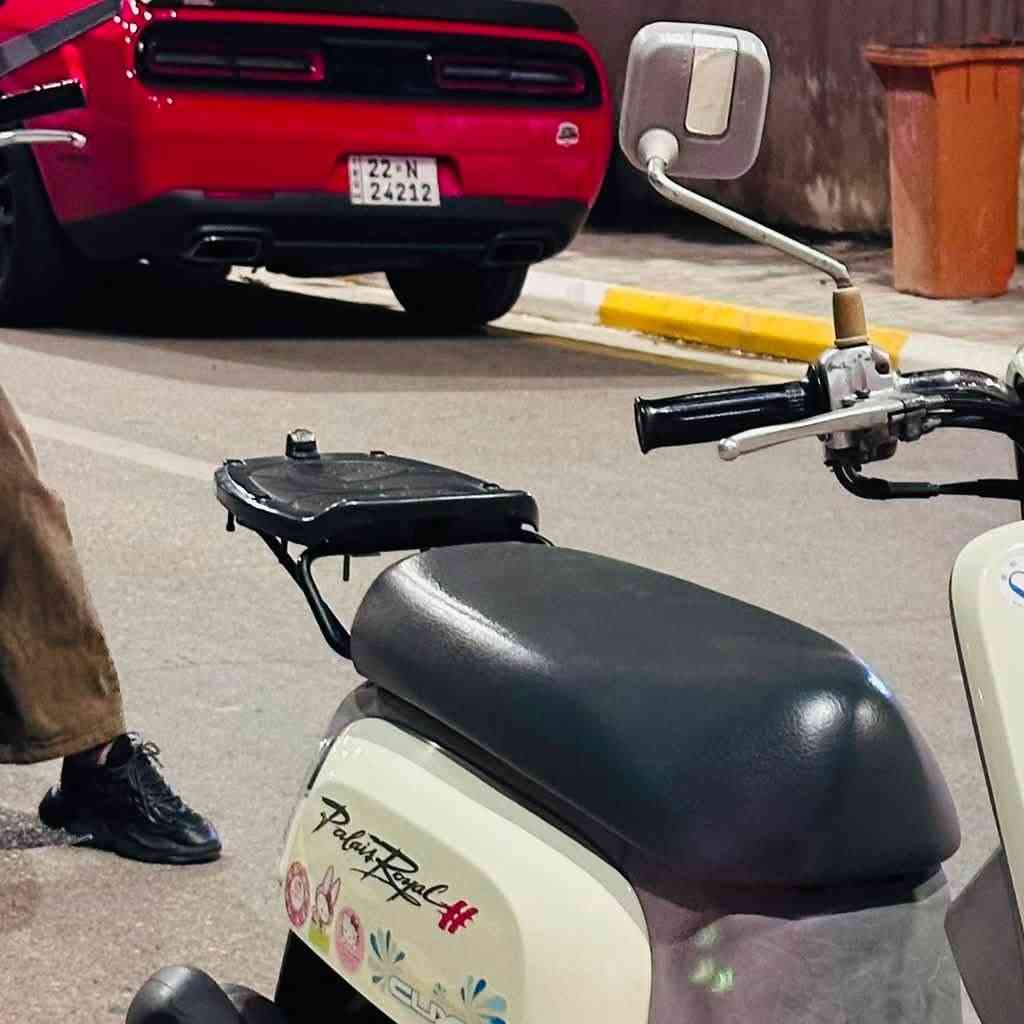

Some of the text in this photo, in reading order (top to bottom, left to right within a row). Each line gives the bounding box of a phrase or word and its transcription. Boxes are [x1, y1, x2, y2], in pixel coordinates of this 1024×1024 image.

[367, 159, 391, 178] 22
[406, 160, 418, 178] N
[370, 182, 431, 201] 24212
[312, 796, 378, 863] Palais
[350, 832, 450, 907] Royal
